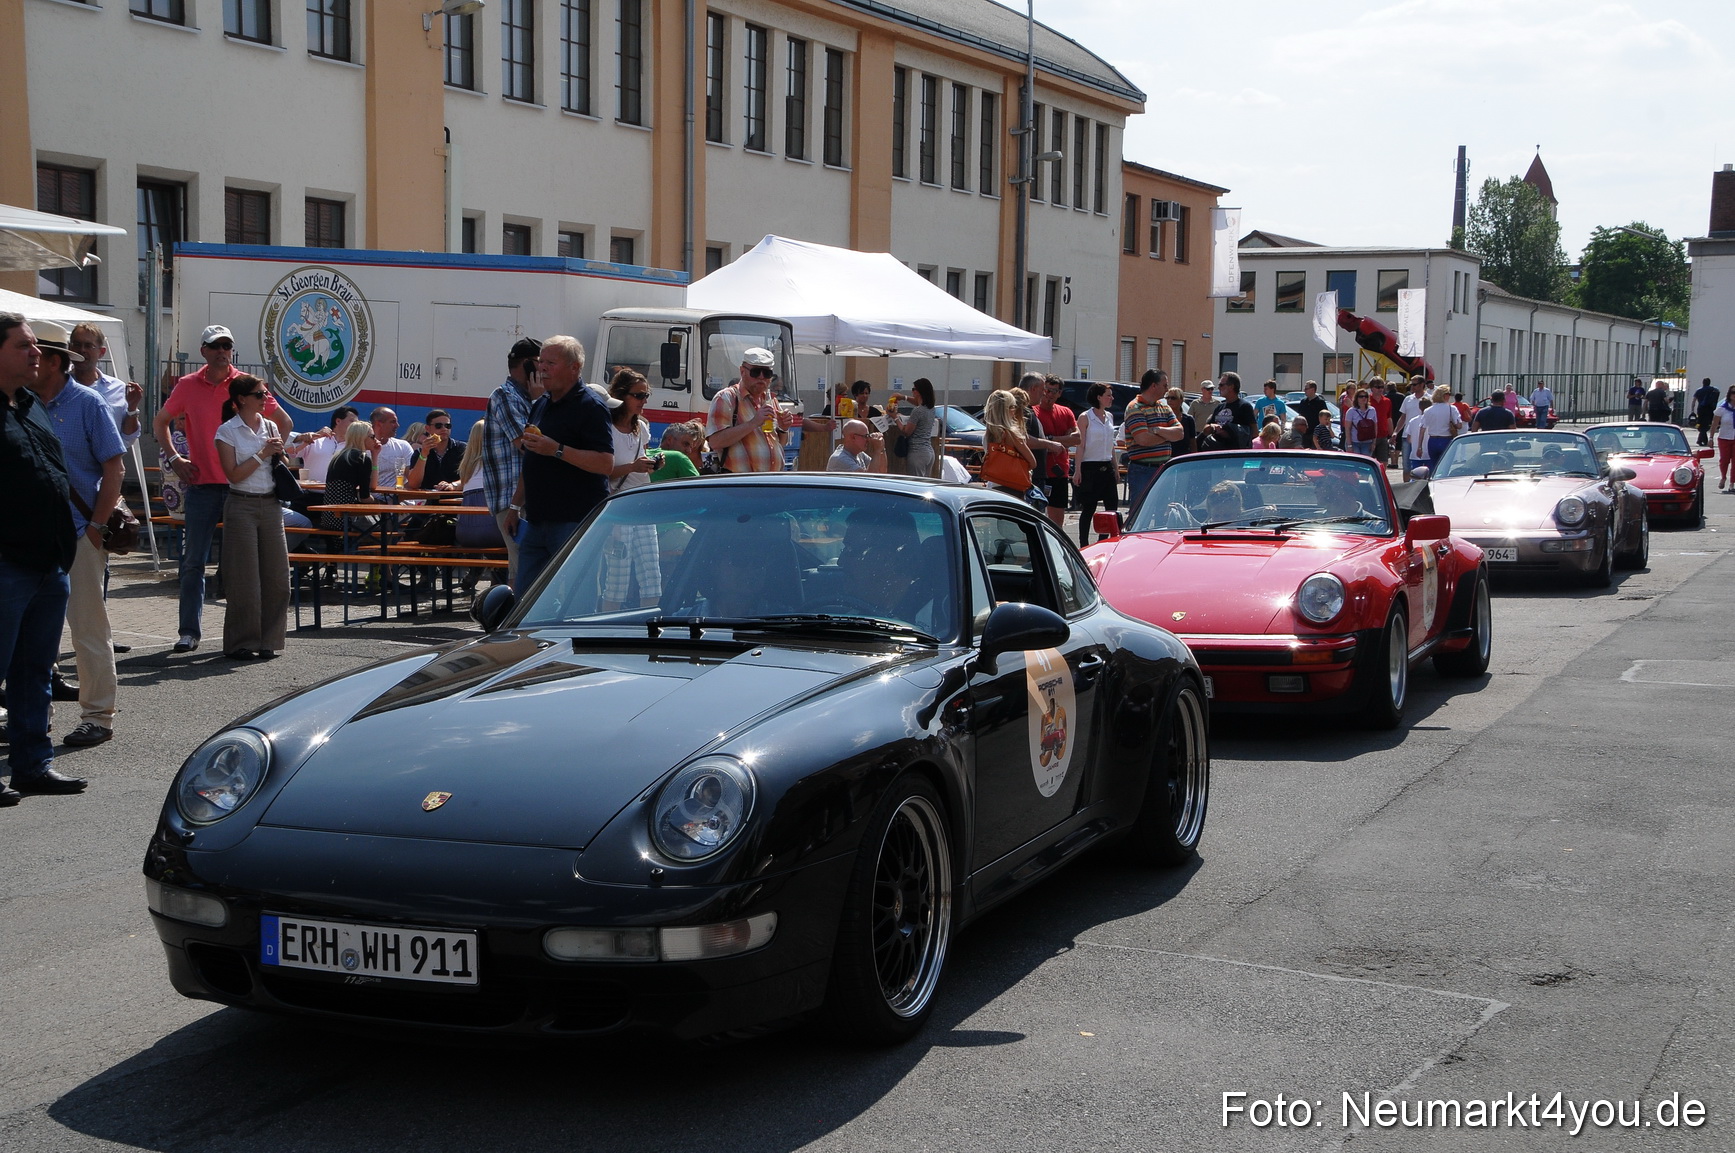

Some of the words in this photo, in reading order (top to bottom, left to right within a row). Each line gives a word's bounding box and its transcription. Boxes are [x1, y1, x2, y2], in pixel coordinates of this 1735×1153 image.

[330, 274, 354, 303] Bräu
[1063, 275, 1072, 305] 5
[399, 363, 421, 380] 1624
[289, 379, 344, 404] Buttenheim
[1488, 549, 1509, 560] 964
[1037, 676, 1063, 692] PORSCHE
[266, 944, 274, 956] D
[281, 922, 338, 966] ERH
[361, 931, 401, 972] WH
[410, 935, 473, 978] 911
